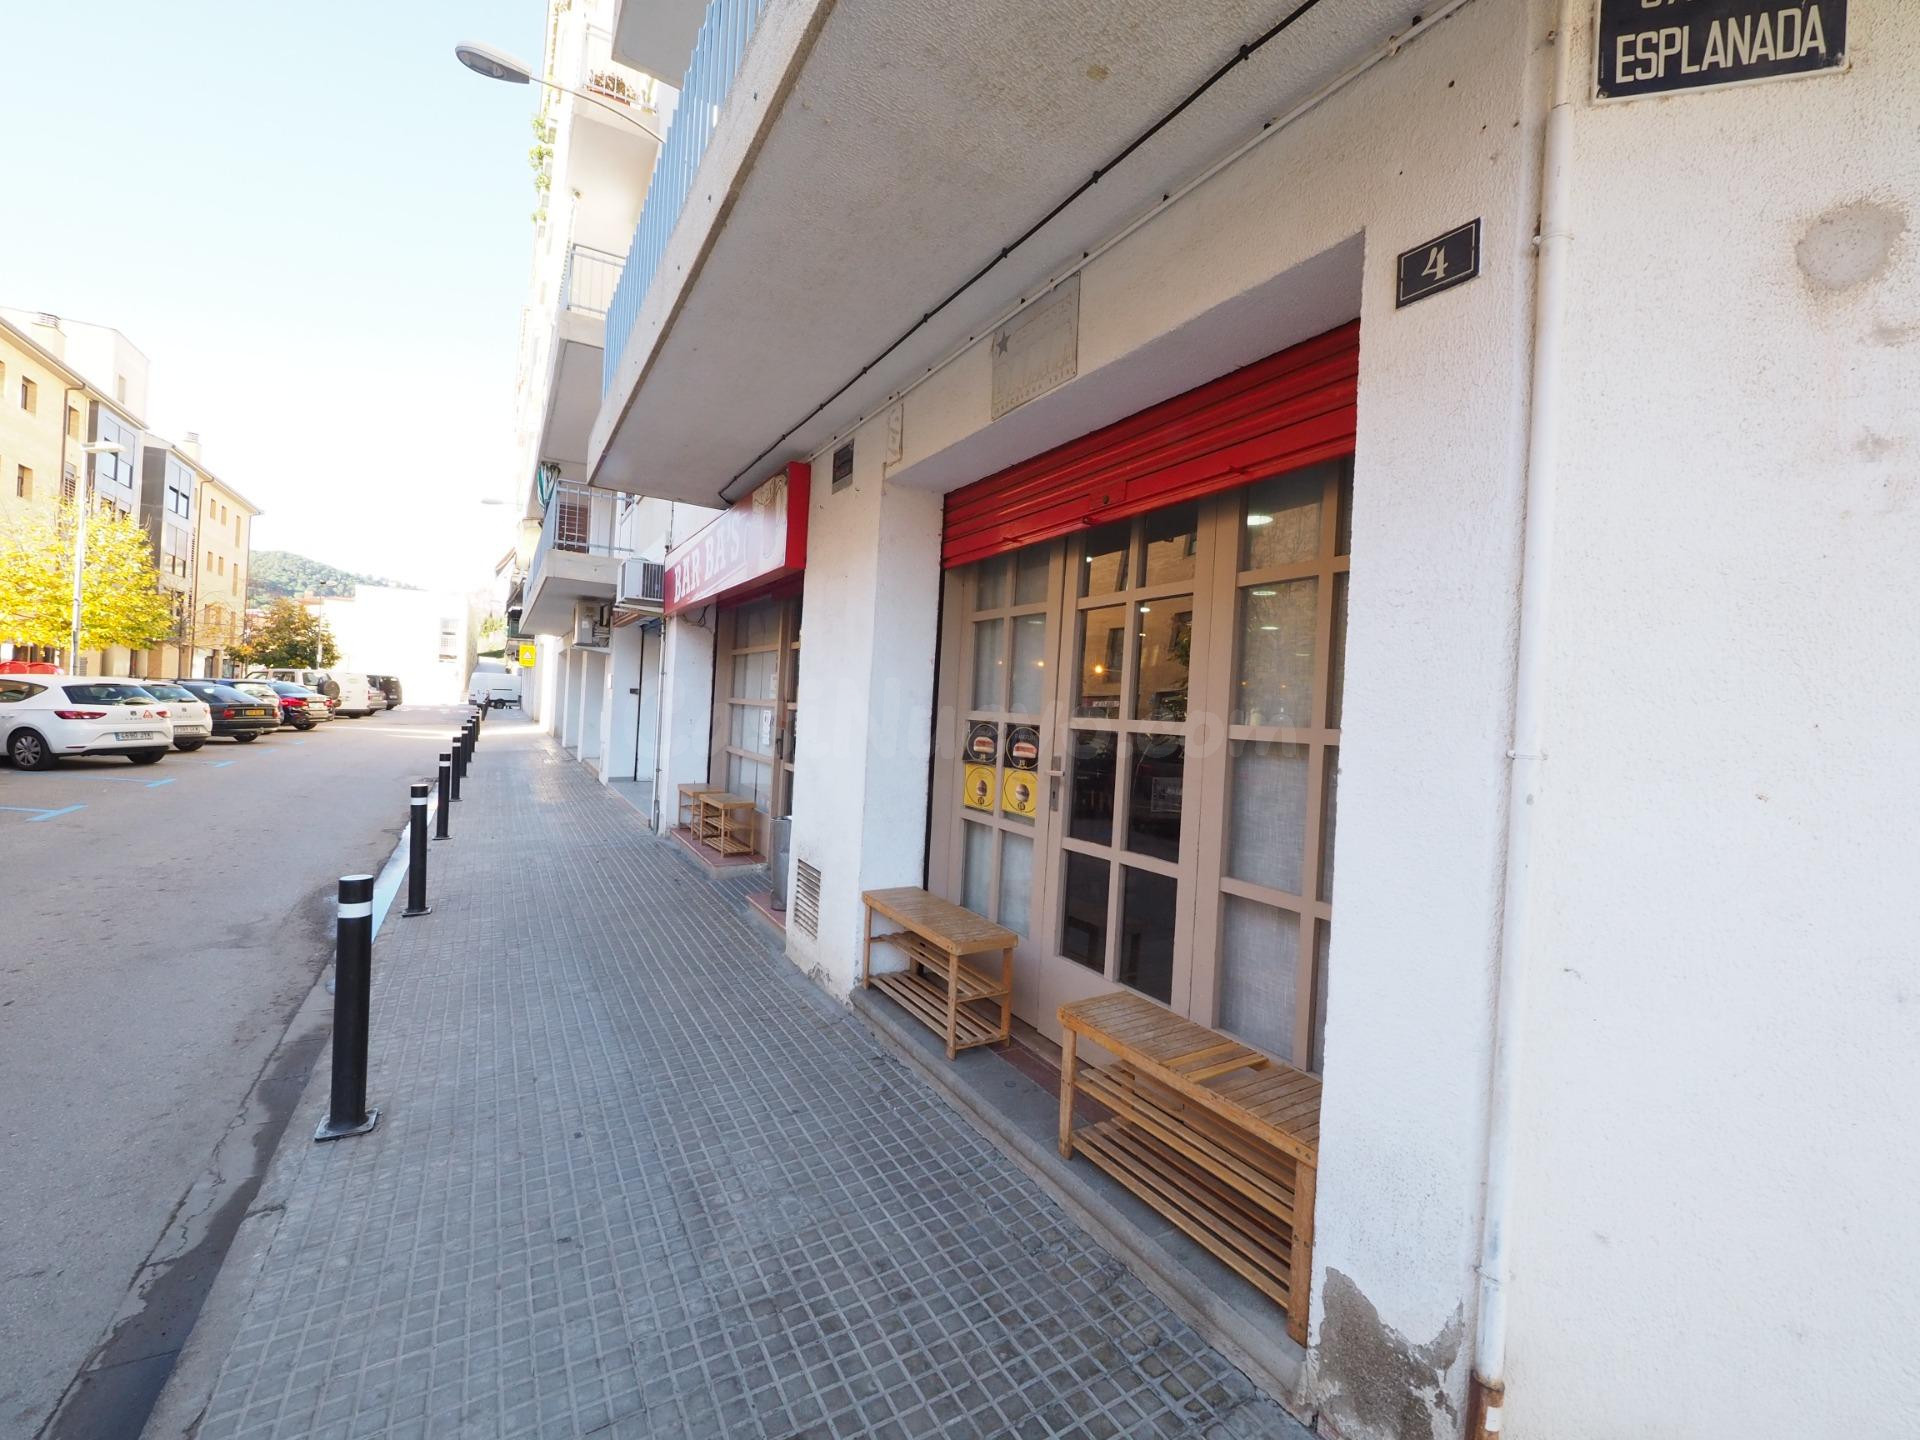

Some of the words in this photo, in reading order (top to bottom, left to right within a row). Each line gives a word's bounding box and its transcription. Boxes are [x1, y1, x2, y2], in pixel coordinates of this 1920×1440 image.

[1616, 4, 1826, 84] ESPLANADA
[1421, 245, 1449, 281] 4
[673, 547, 701, 603] BAR
